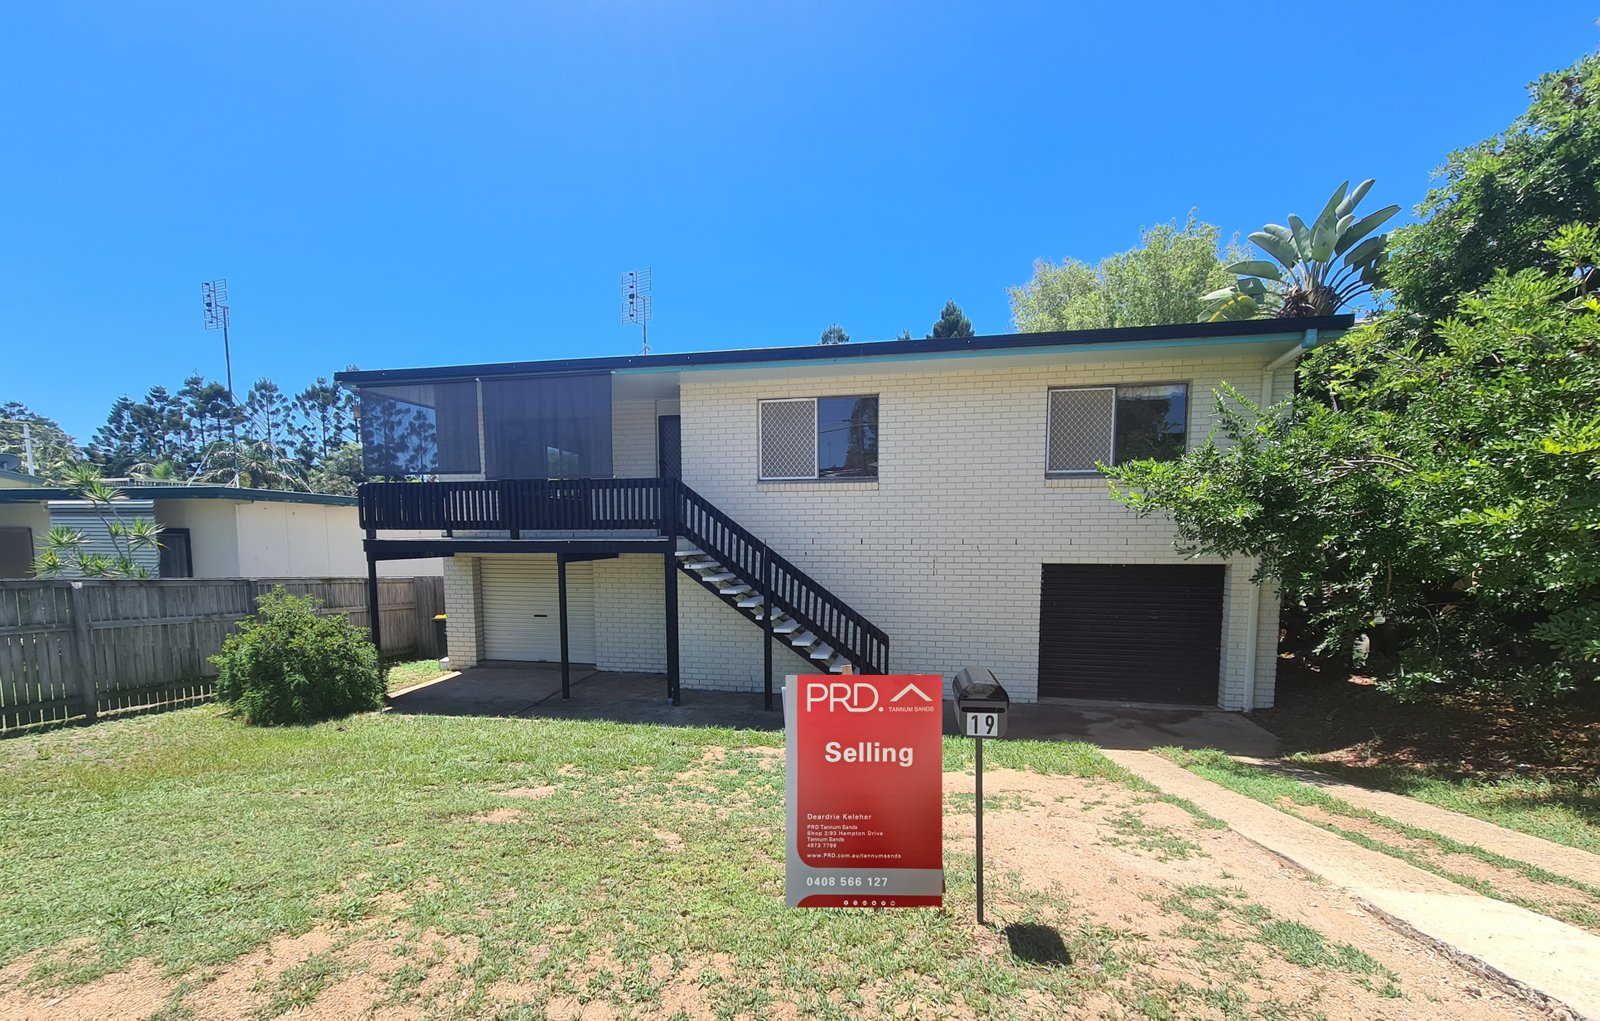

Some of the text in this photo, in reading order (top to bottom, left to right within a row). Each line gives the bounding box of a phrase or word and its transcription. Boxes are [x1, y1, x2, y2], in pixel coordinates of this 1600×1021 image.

[971, 714, 995, 735] 19
[824, 741, 913, 768] Selling
[806, 877, 888, 887] 0408 566 127
